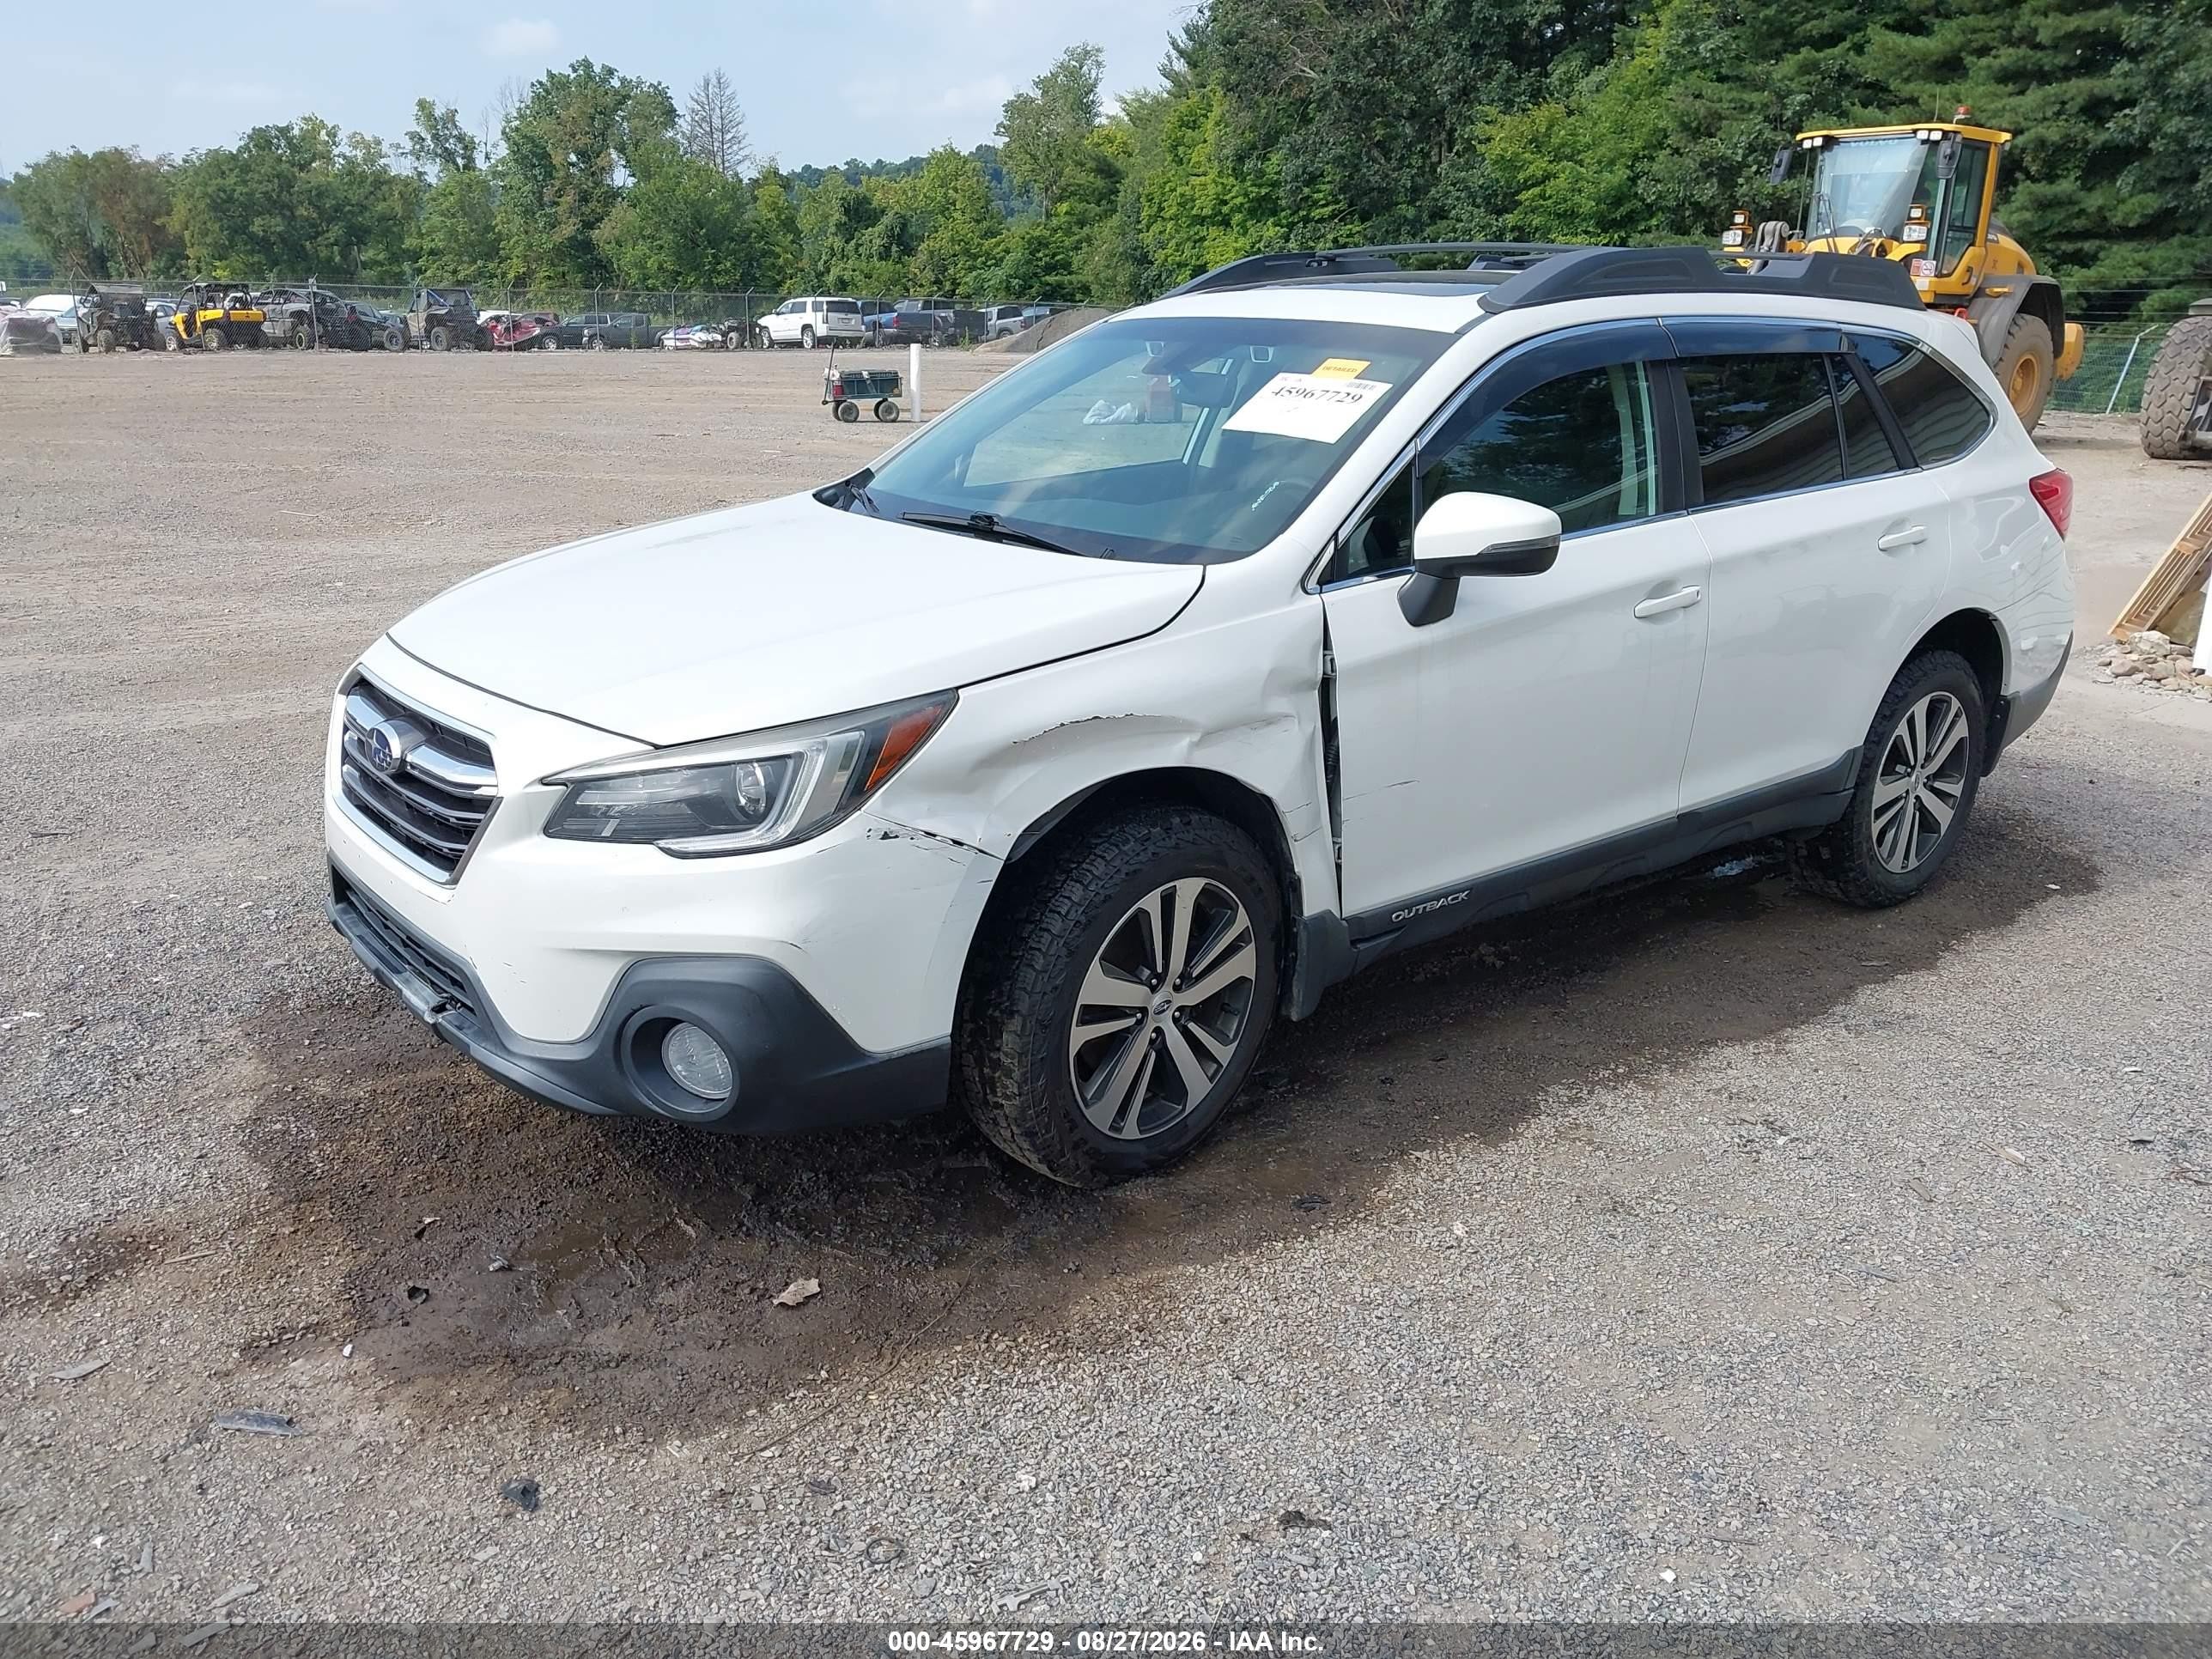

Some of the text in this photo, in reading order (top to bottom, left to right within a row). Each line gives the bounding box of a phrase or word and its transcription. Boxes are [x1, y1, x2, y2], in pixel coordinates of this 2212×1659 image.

[1851, 138, 1897, 147] VOLVO
[1272, 386, 1364, 404] 45967729
[1391, 890, 1470, 922] OUTBACK
